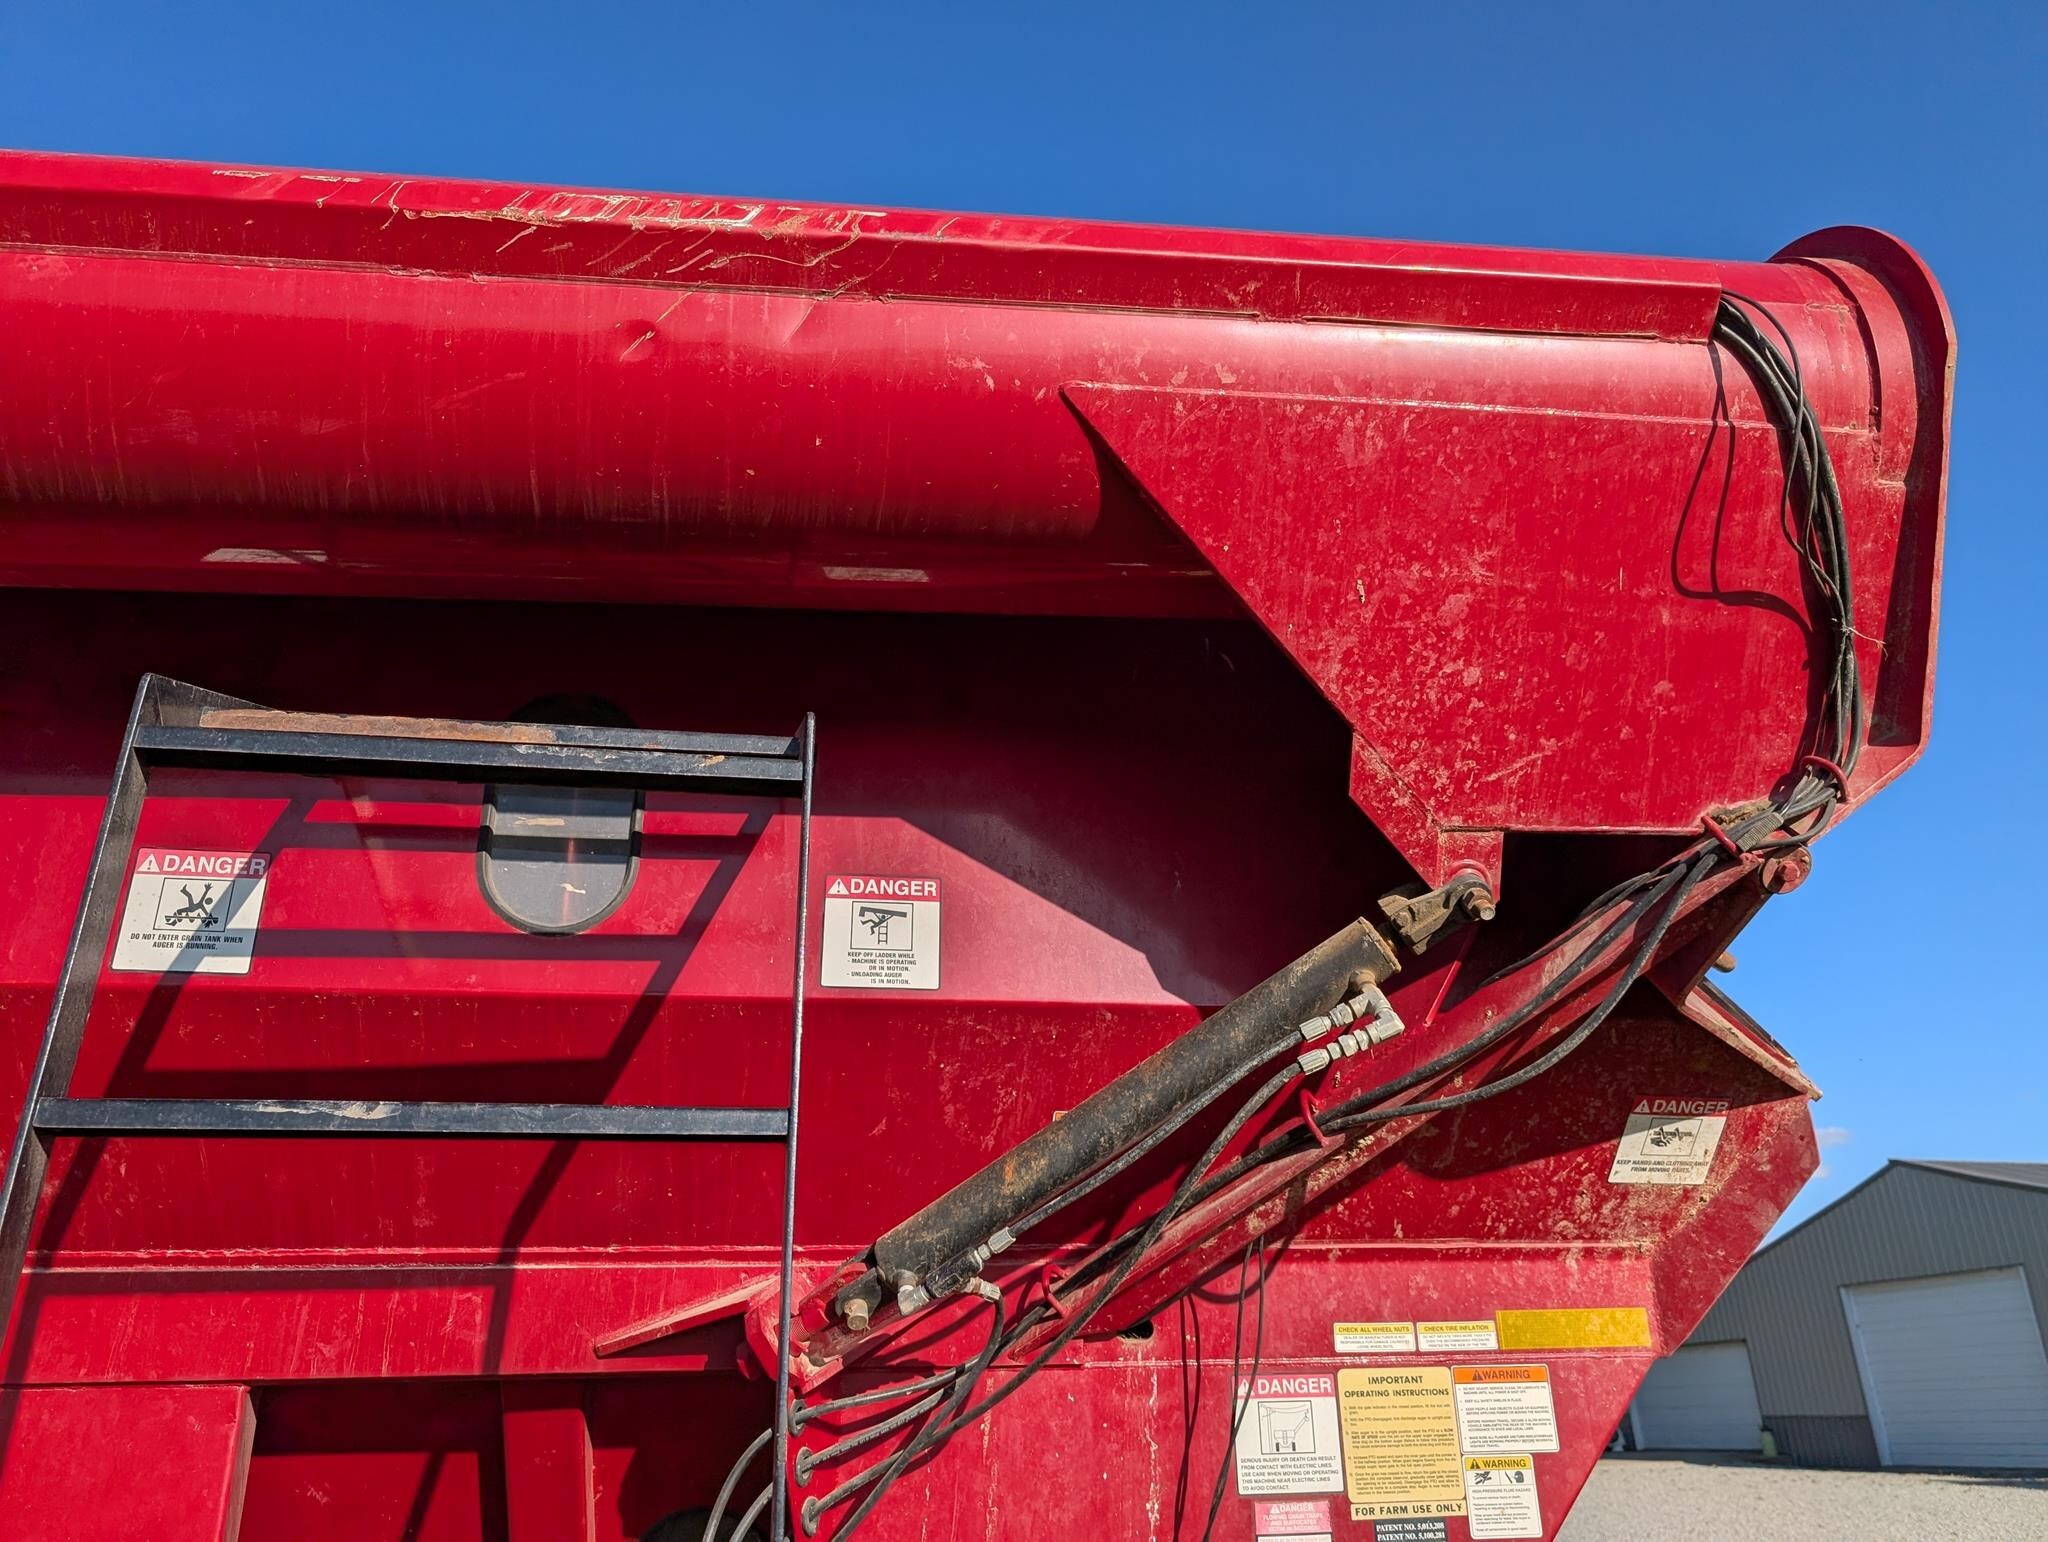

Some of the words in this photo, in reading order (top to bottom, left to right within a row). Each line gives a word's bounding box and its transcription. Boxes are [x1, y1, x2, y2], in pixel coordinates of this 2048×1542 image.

[163, 855, 266, 875] DANGER
[850, 879, 936, 896] DANGER
[1652, 1100, 1728, 1114] DANGER
[1482, 1370, 1530, 1379] WARNING
[1368, 1376, 1423, 1384] IMPORTANT
[1257, 1378, 1331, 1394] DANGER
[1344, 1390, 1390, 1398] OPERATING
[1393, 1388, 1449, 1397] INSTRUCTIONS
[1482, 1459, 1526, 1468] WARNING
[1279, 1503, 1314, 1512] DANGER
[1355, 1507, 1375, 1516] FOR
[1380, 1506, 1408, 1515] FARM
[1413, 1505, 1432, 1513] USE
[1436, 1503, 1462, 1512] ONLY
[1403, 1523, 1416, 1531] NO.
[1377, 1533, 1403, 1541] PATENT
